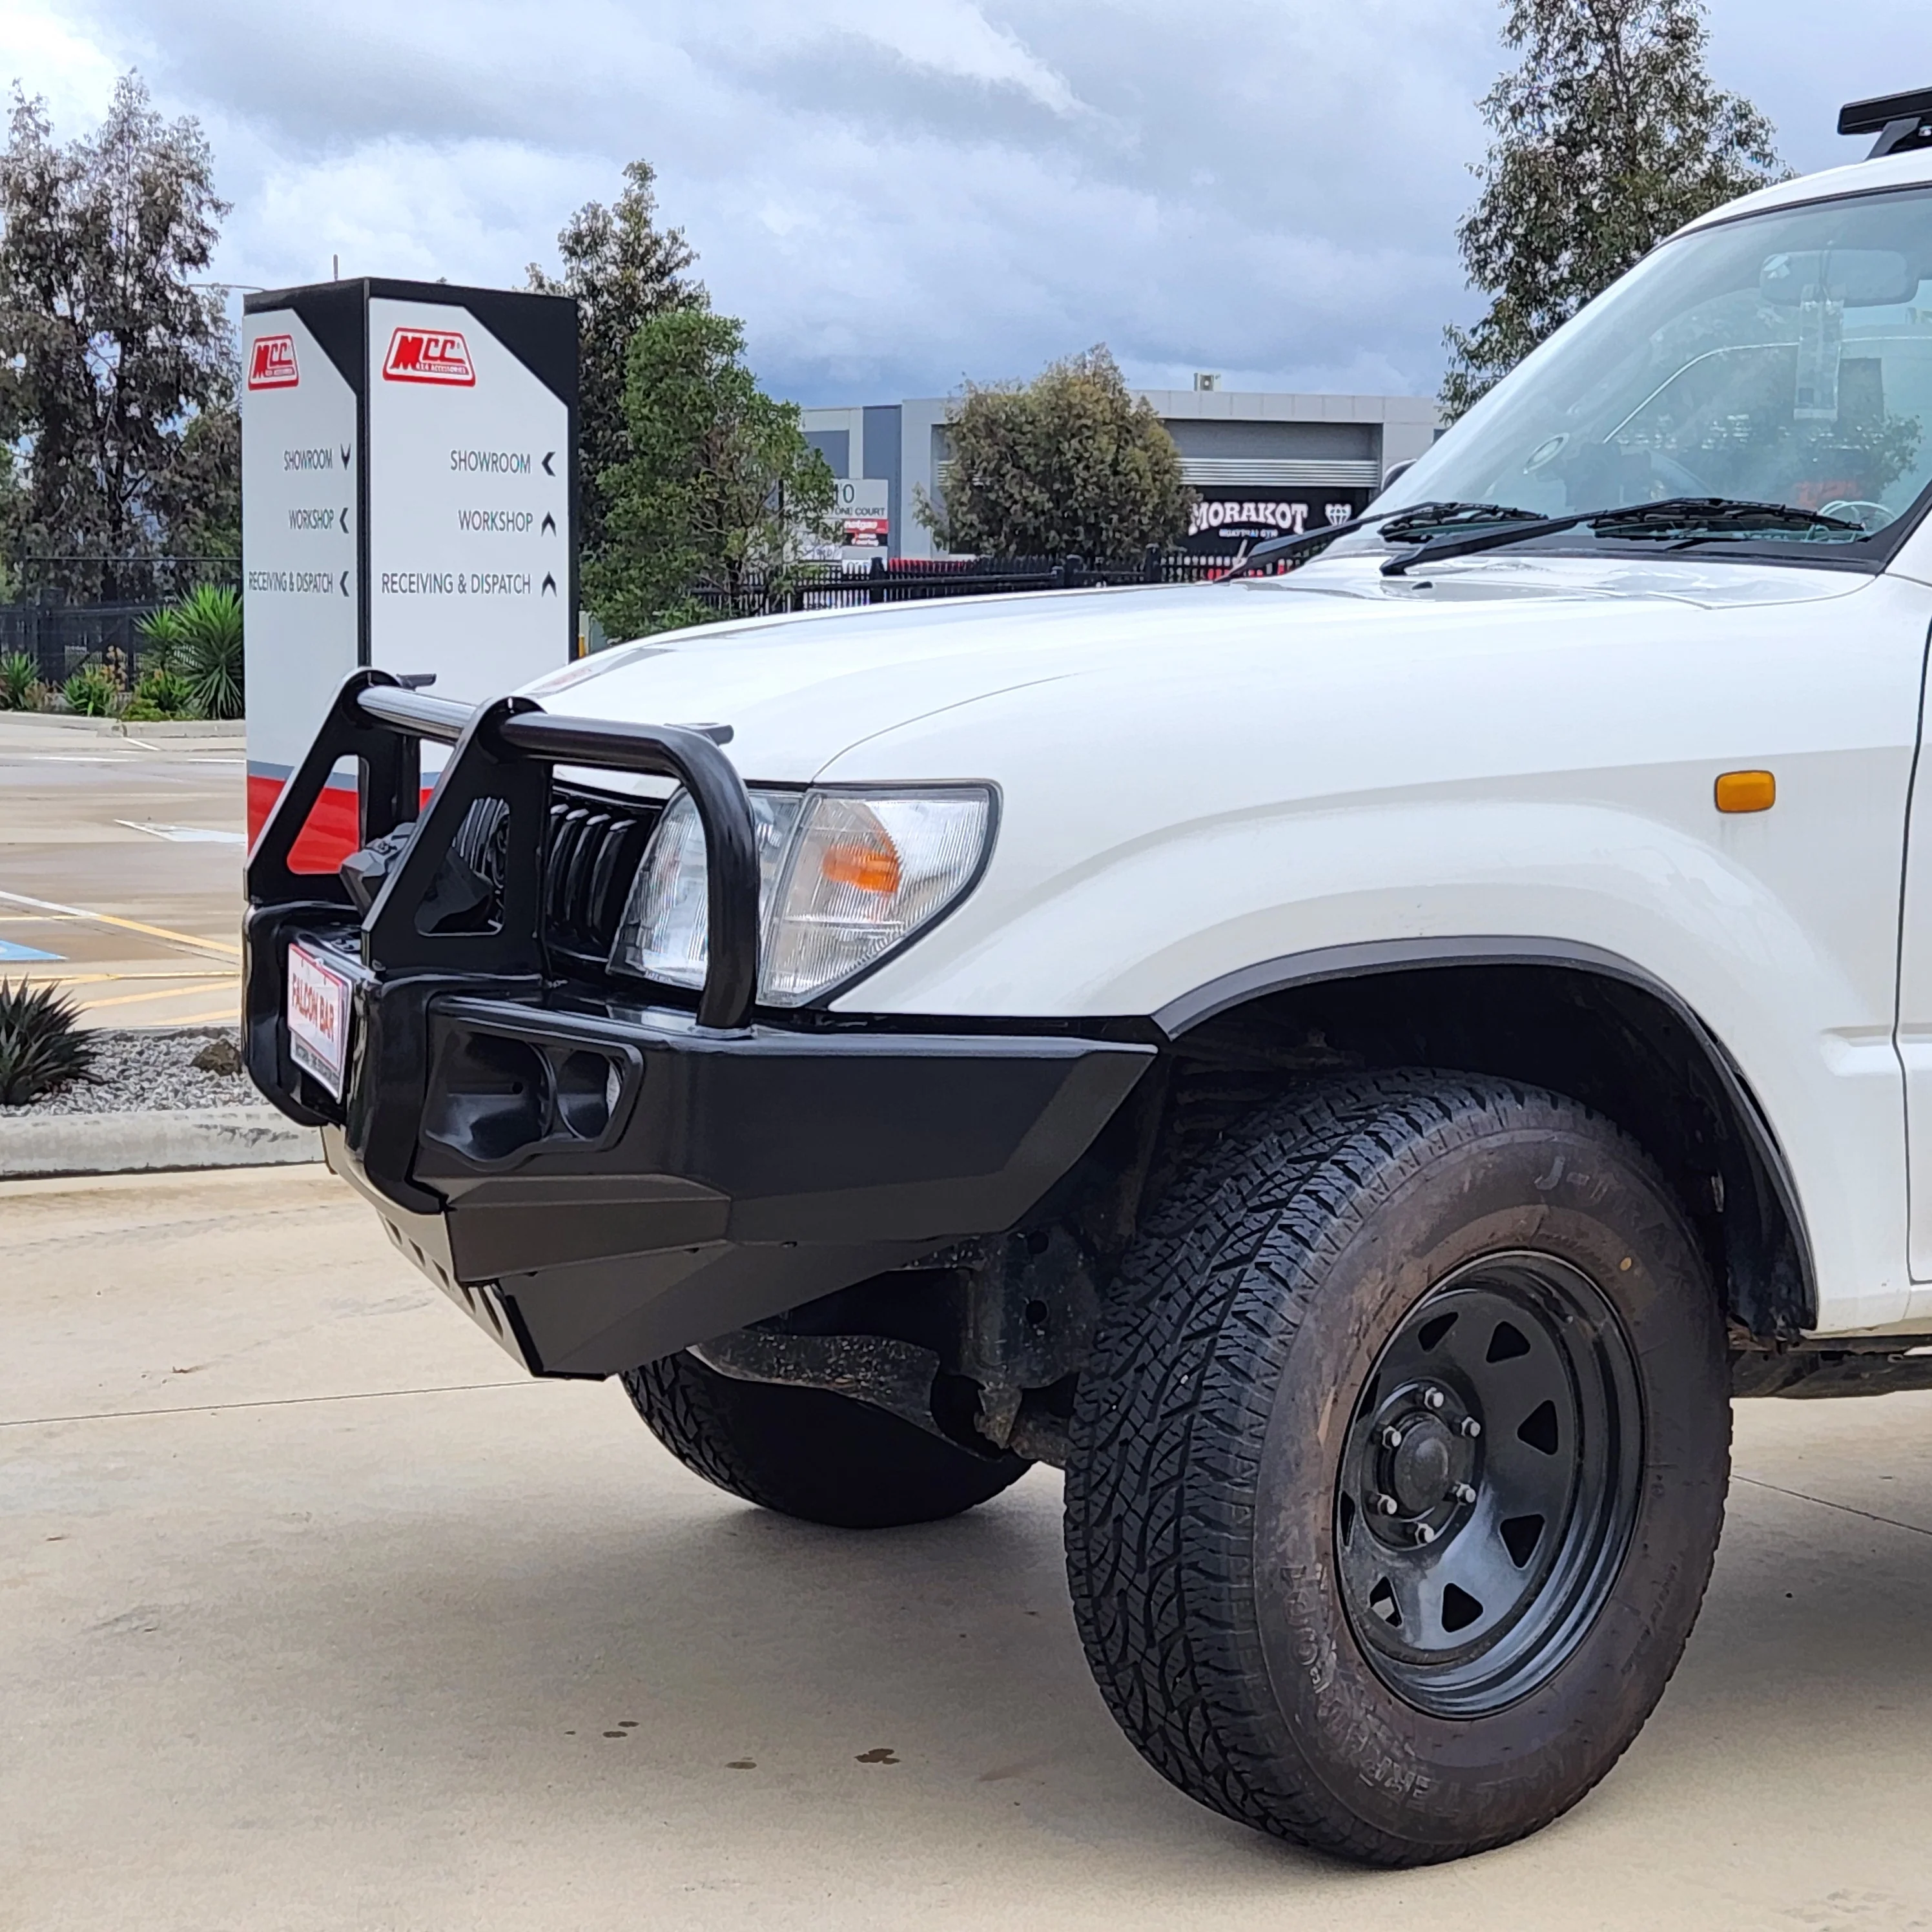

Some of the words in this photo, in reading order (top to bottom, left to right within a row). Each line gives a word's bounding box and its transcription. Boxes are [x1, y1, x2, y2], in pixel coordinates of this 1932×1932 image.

[252, 342, 293, 378] MCC
[389, 335, 466, 370] MCC
[283, 448, 333, 471] SHOWROOM
[450, 449, 531, 474] SHOWROOM
[289, 509, 334, 529] WORKSHOP
[458, 509, 533, 532] WORKSHOP
[854, 507, 885, 516] COURT
[1188, 502, 1308, 536] MORAKOT
[248, 571, 287, 592] RECEIVING
[289, 571, 294, 592] &
[296, 572, 333, 593] DISPATCH
[382, 573, 453, 594] RECEIVING
[457, 573, 467, 594] &
[471, 573, 531, 595] DISPATCH
[320, 995, 334, 1043] BAR
